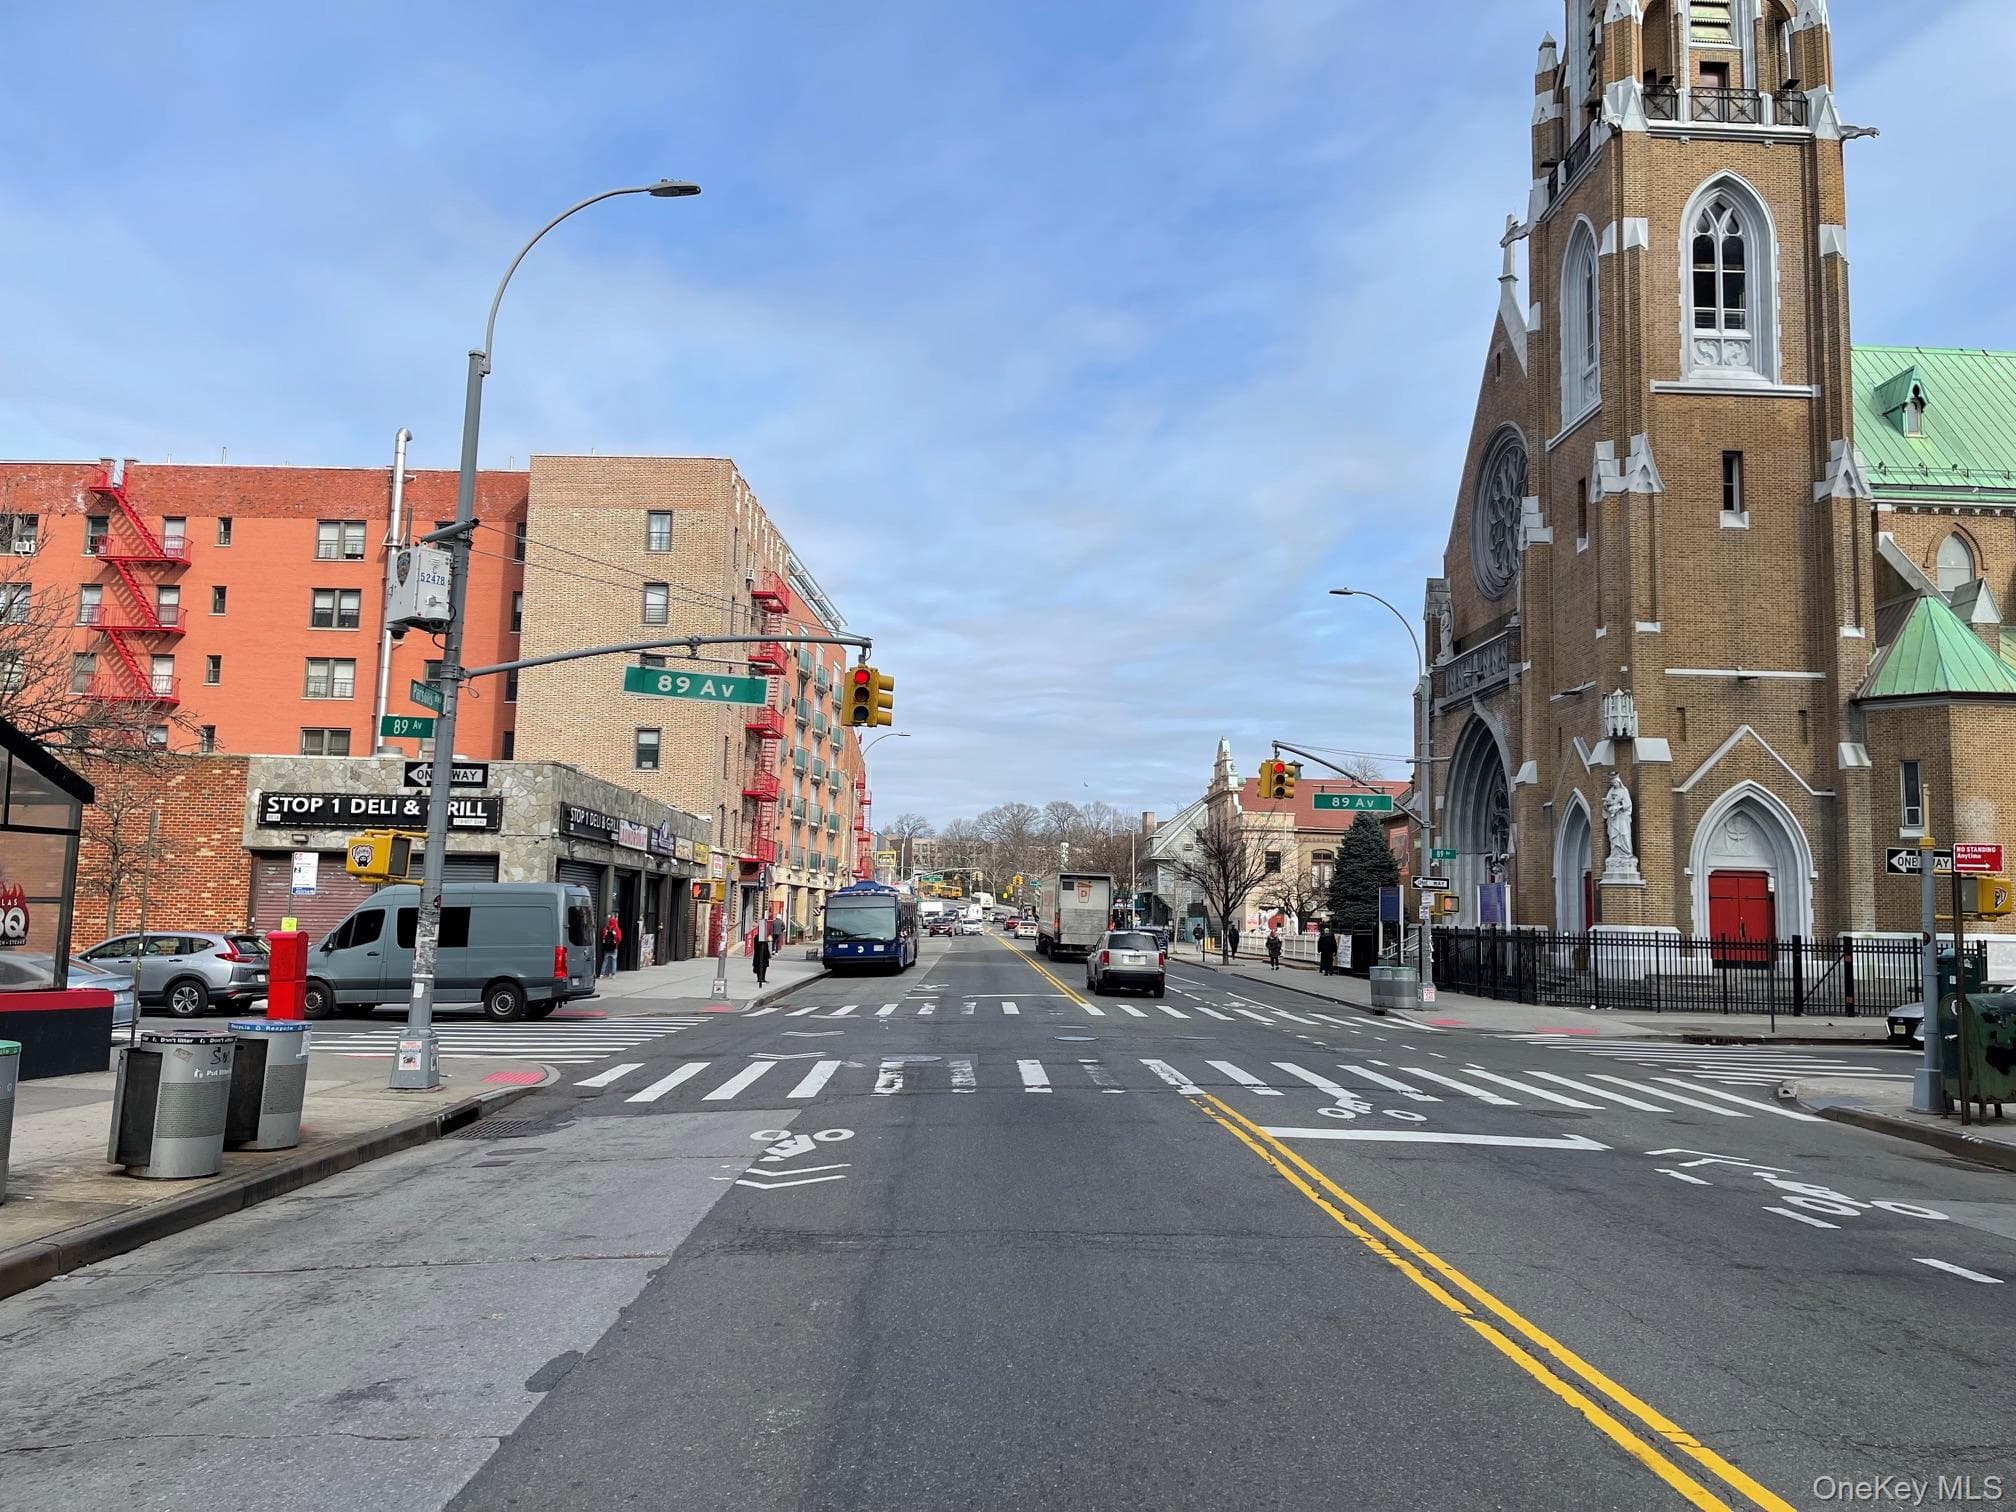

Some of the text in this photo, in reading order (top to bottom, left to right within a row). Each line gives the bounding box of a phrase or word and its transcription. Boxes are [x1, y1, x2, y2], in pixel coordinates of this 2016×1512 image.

[420, 572, 445, 586] 52478
[658, 675, 734, 697] 89 Av
[393, 719, 422, 734] 89 Av
[416, 770, 477, 780] ON WAY
[267, 796, 488, 816] STOP 1 DELI & RILL
[1331, 797, 1374, 808] 89 Av
[570, 807, 585, 824] STOP
[1897, 857, 1918, 867] ONE
